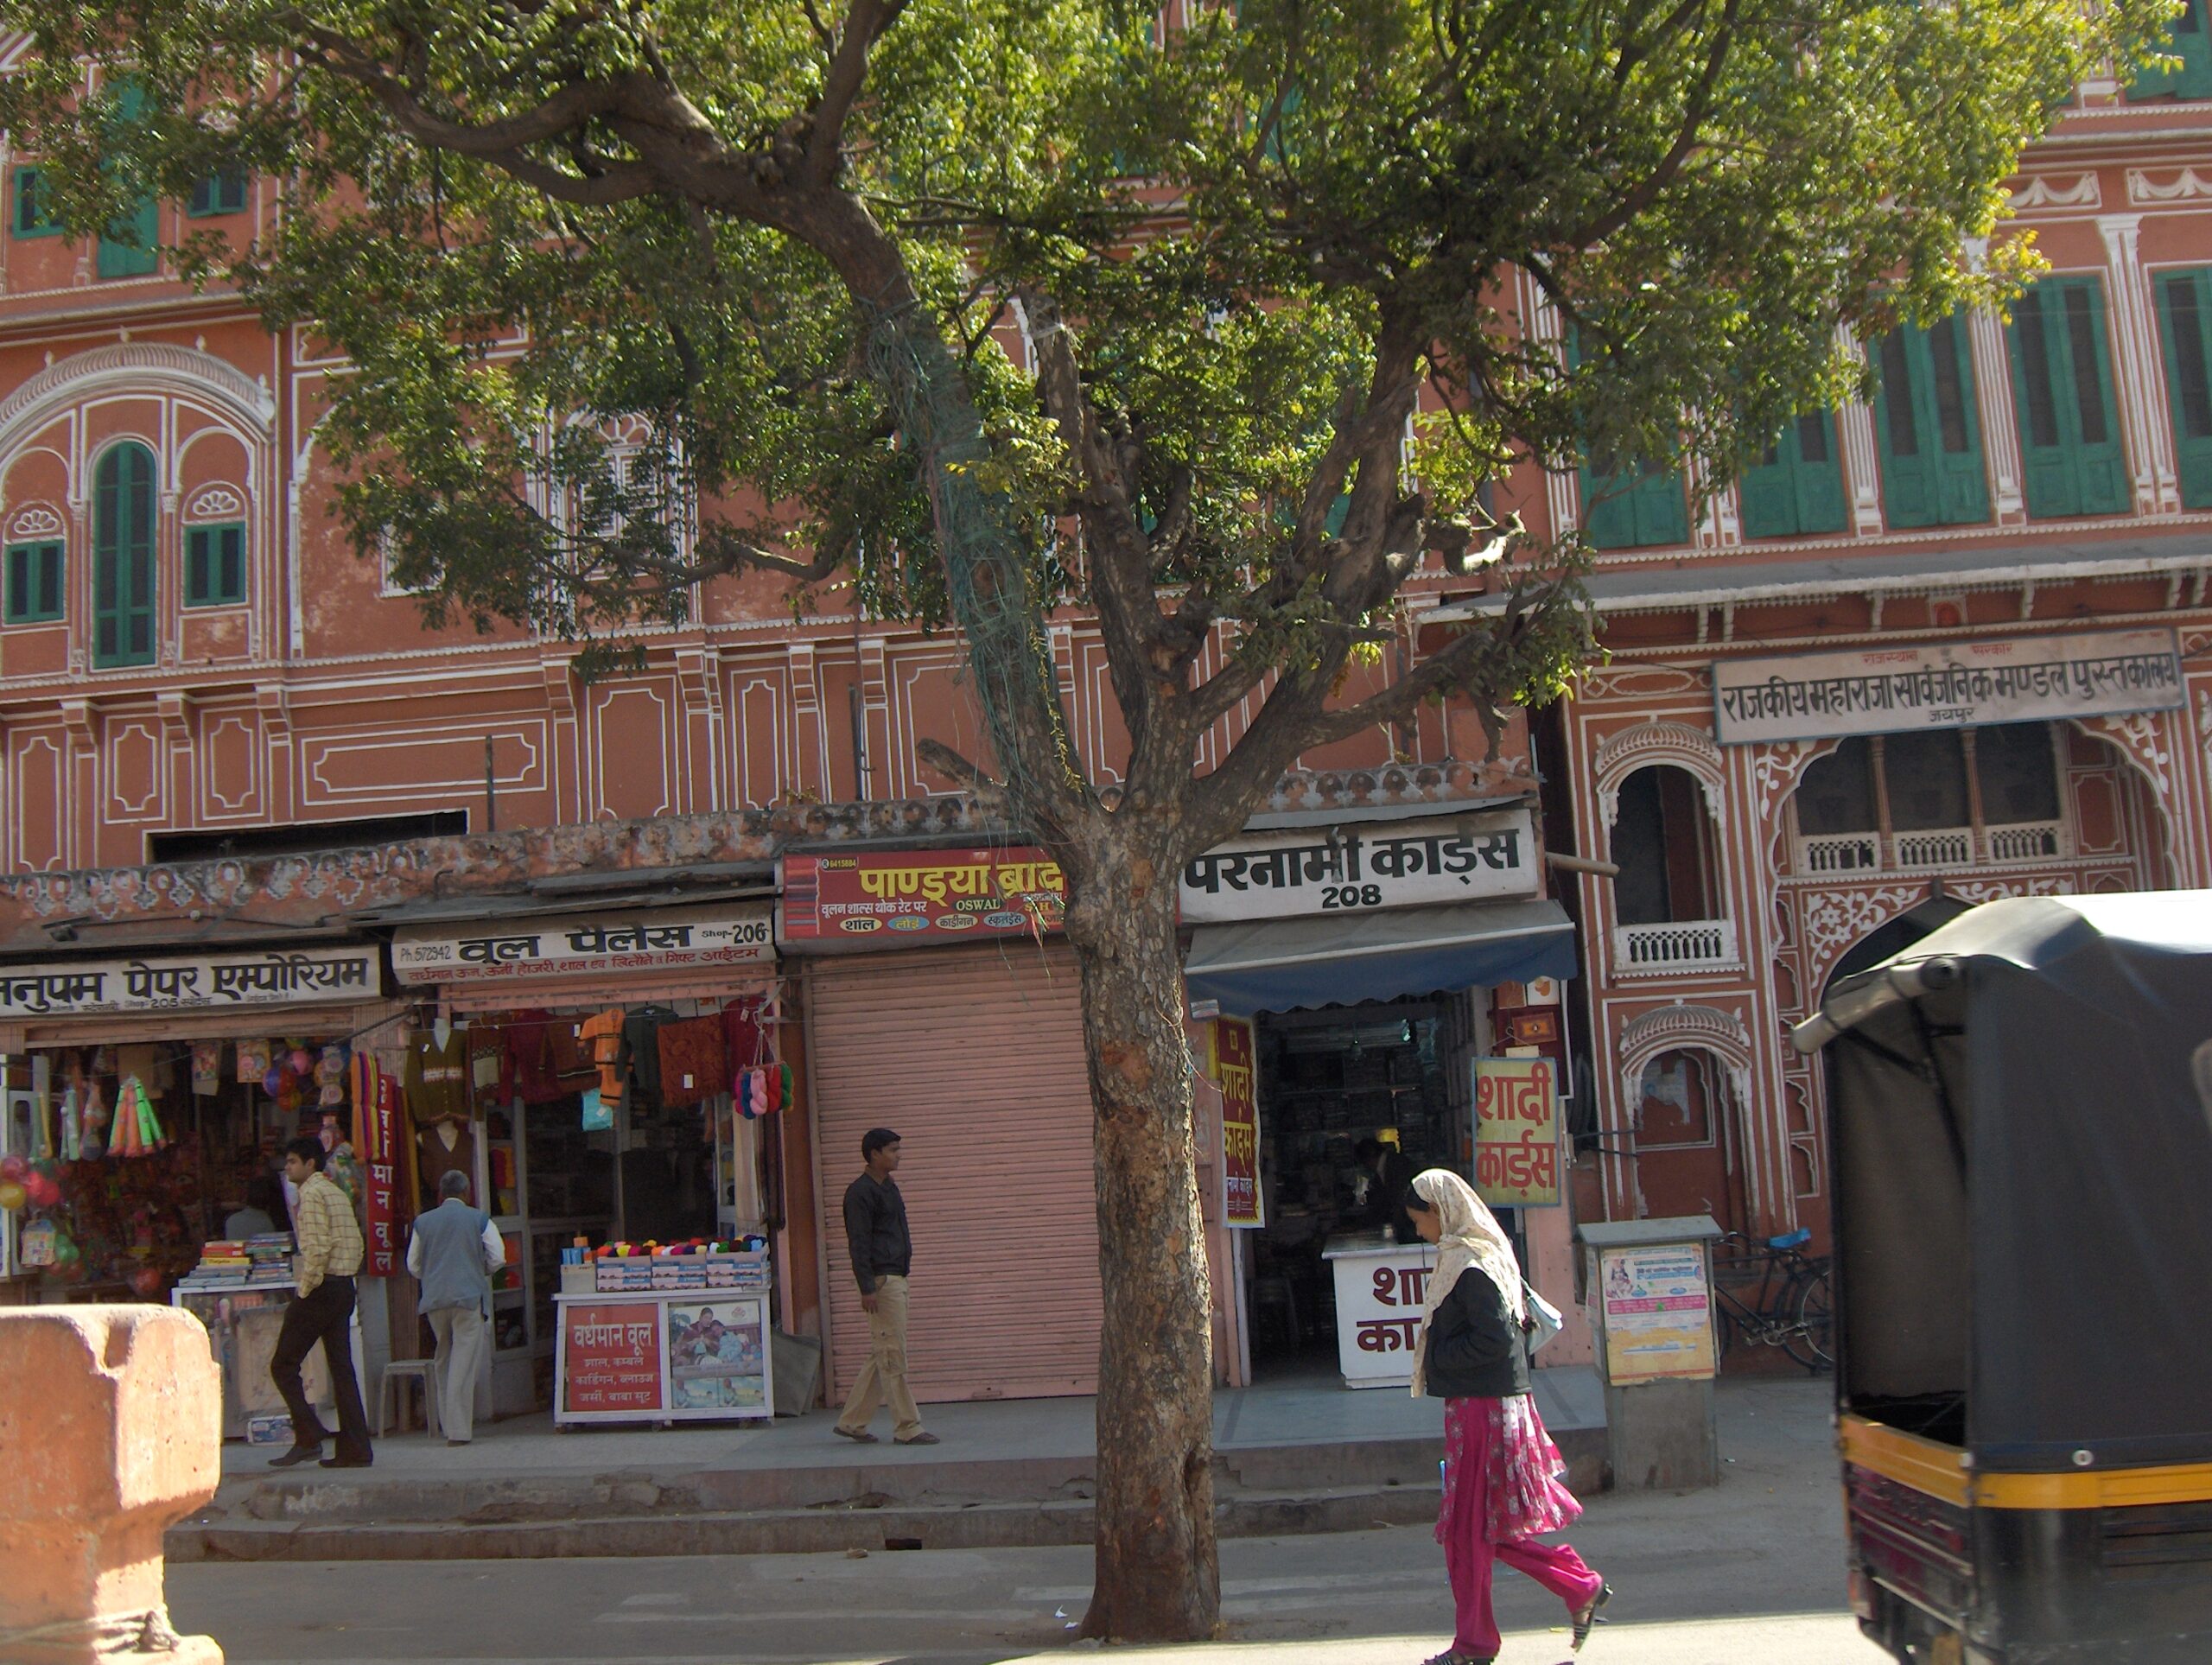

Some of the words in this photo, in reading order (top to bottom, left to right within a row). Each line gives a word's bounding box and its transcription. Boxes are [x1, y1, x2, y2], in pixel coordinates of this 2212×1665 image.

[1722, 676, 1809, 722] राजकीय
[1809, 674, 1894, 716] महाराजा
[1894, 663, 1993, 709] सार्वजनिक
[1993, 661, 2070, 699] मण्डल
[2070, 652, 2178, 700] पुस्तकालय
[1929, 707, 1974, 723] जयपुर
[1184, 829, 1363, 893] परनामी
[996, 861, 1064, 900] ब्राद
[1321, 884, 1382, 908] 208
[821, 904, 847, 919] वूलन
[848, 903, 873, 915] शाल्स
[874, 899, 897, 913] थोक
[898, 899, 912, 912] रेट
[913, 901, 927, 912] पर
[957, 899, 1001, 912] OSWAL
[408, 966, 453, 982] वर्धमान
[560, 959, 587, 972] शाल
[699, 946, 761, 963] आईटम
[459, 935, 541, 965] वूल
[123, 961, 201, 998] पेपर
[212, 954, 369, 1001] एम्पोरियम
[150, 997, 179, 1009] 205
[1221, 1051, 1250, 1109] शादी
[1476, 1062, 1551, 1126] शादी
[1373, 1267, 1434, 1306] शा
[573, 1312, 625, 1348] वर्धमान
[626, 1322, 653, 1356] वूल
[1357, 1318, 1422, 1352] का
[608, 1391, 632, 1401] बाबा
[634, 1391, 651, 1404] सूट
